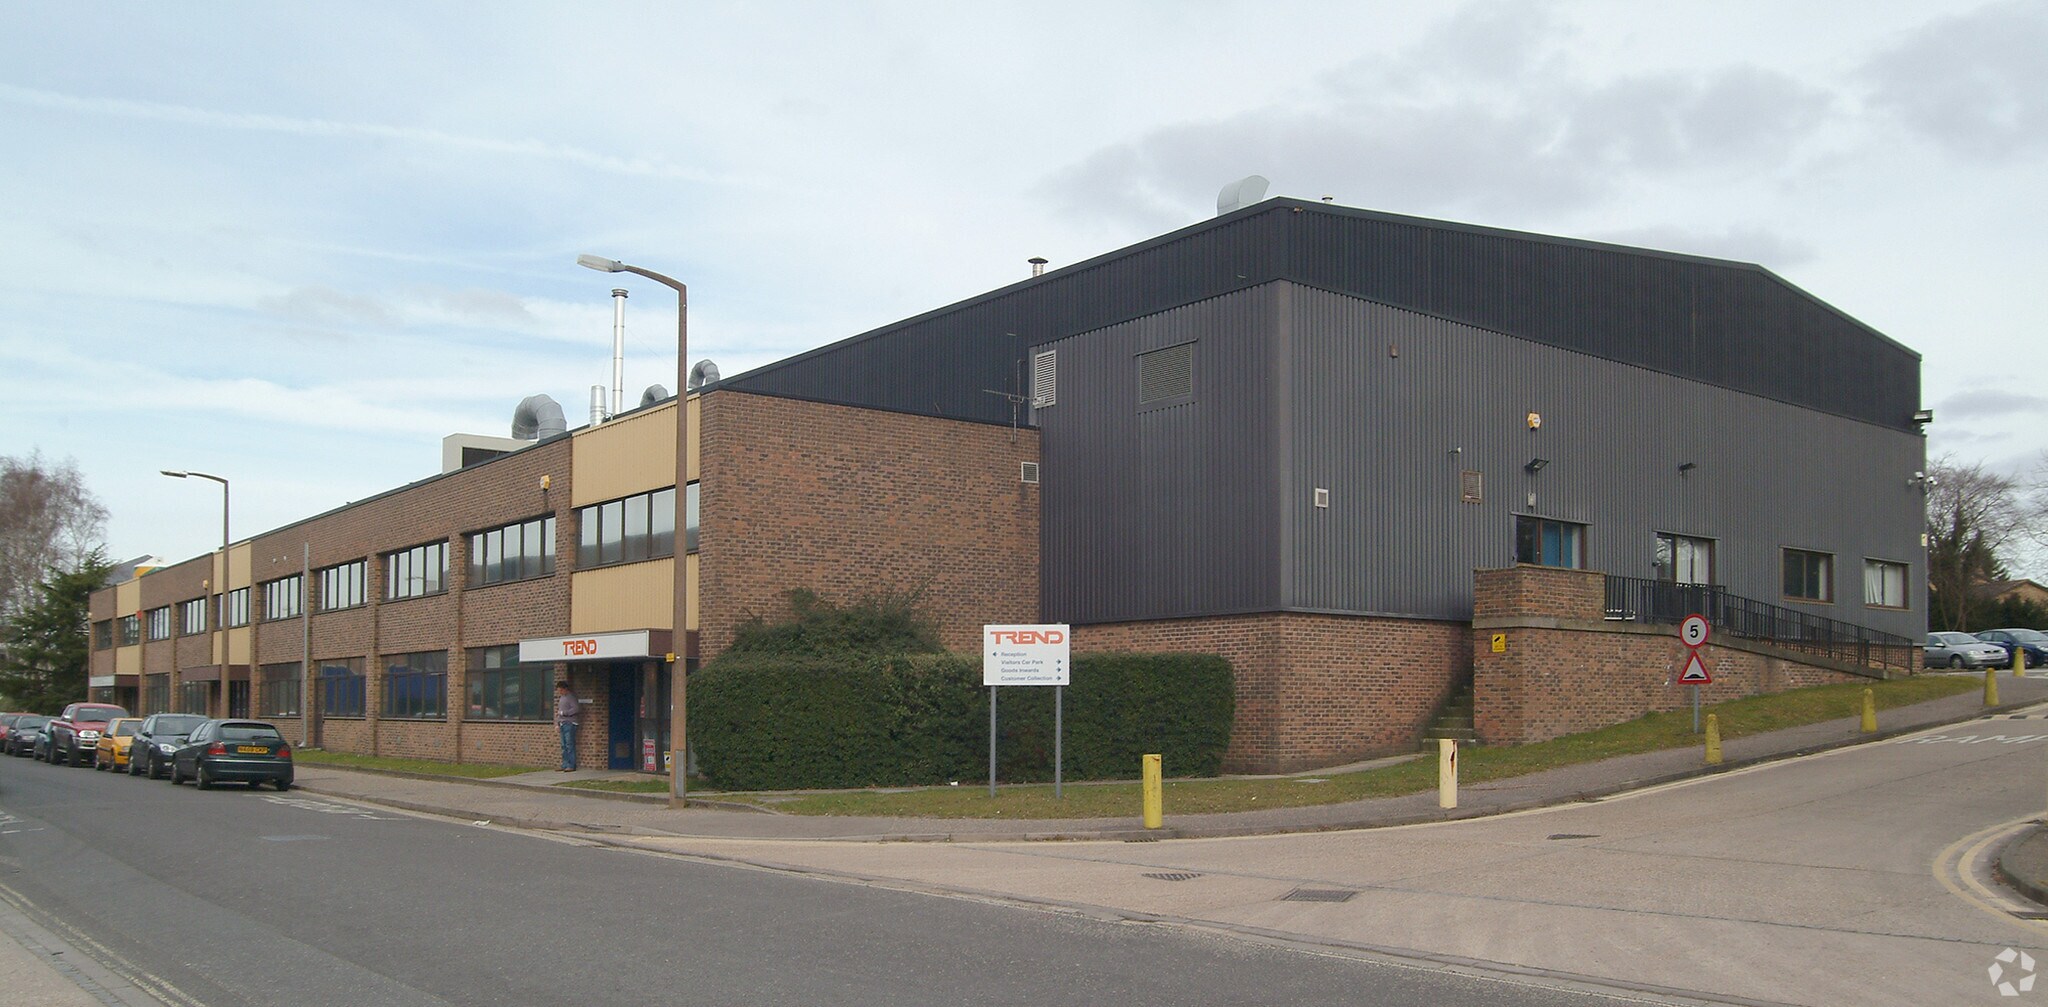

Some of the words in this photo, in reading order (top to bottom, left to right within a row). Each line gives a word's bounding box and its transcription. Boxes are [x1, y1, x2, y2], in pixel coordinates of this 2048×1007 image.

[990, 631, 1064, 645] TREND
[1690, 624, 1699, 638] 5
[562, 639, 597, 656] TREND
